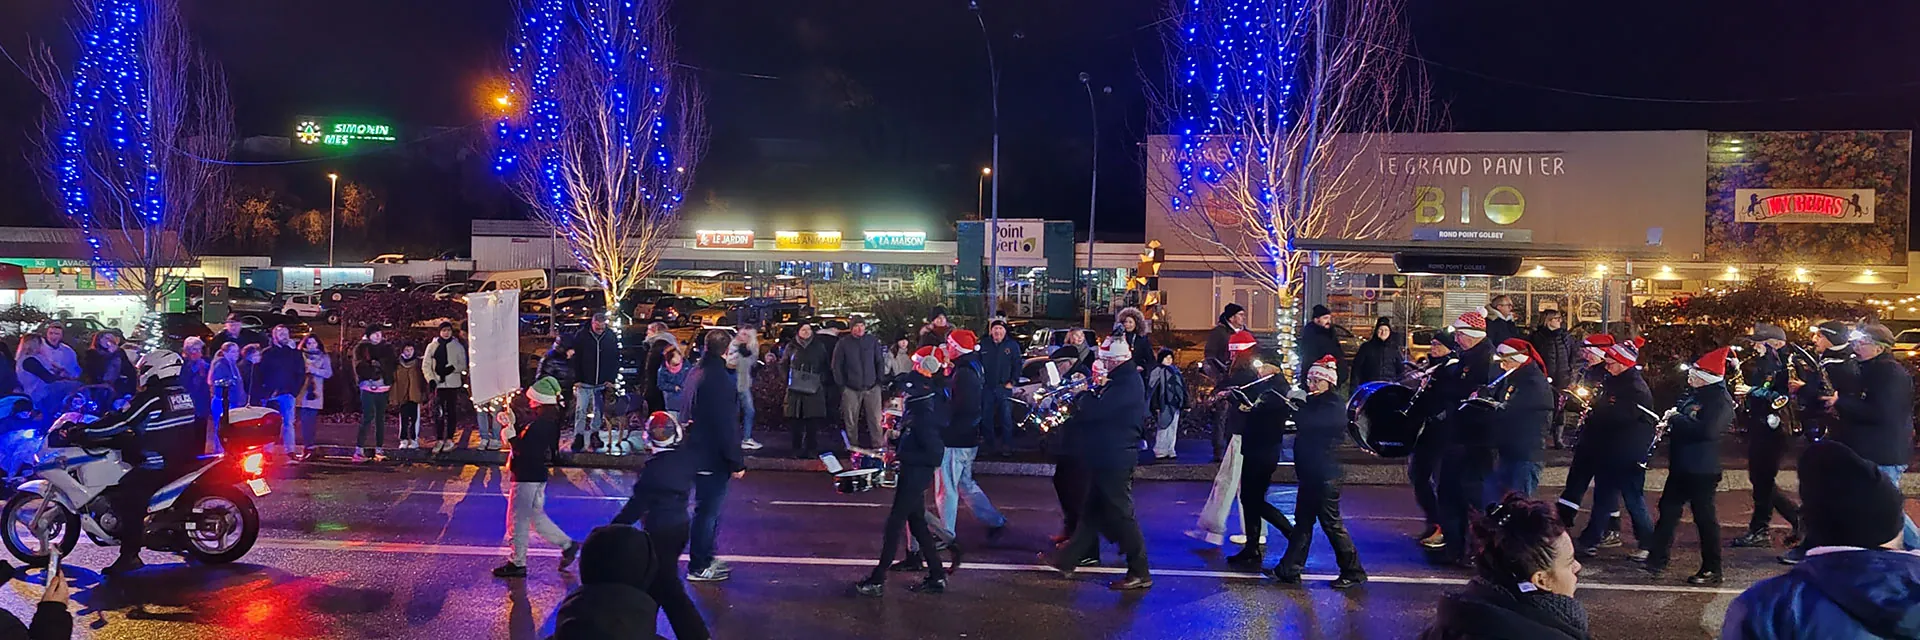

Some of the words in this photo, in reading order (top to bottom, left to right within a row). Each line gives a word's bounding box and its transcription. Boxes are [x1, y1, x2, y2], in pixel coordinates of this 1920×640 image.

[334, 123, 389, 135] SIMONIN
[1405, 157, 1472, 175] GRAND
[1483, 157, 1566, 175] PANIER
[1415, 186, 1526, 224] BIO
[1766, 195, 1791, 216] MY
[1793, 194, 1844, 216] BEERS
[712, 234, 721, 244] LE
[721, 234, 748, 244] JARDIN
[879, 236, 889, 246] LA
[890, 236, 923, 246] MAISON
[1478, 231, 1504, 239] GOLBEY
